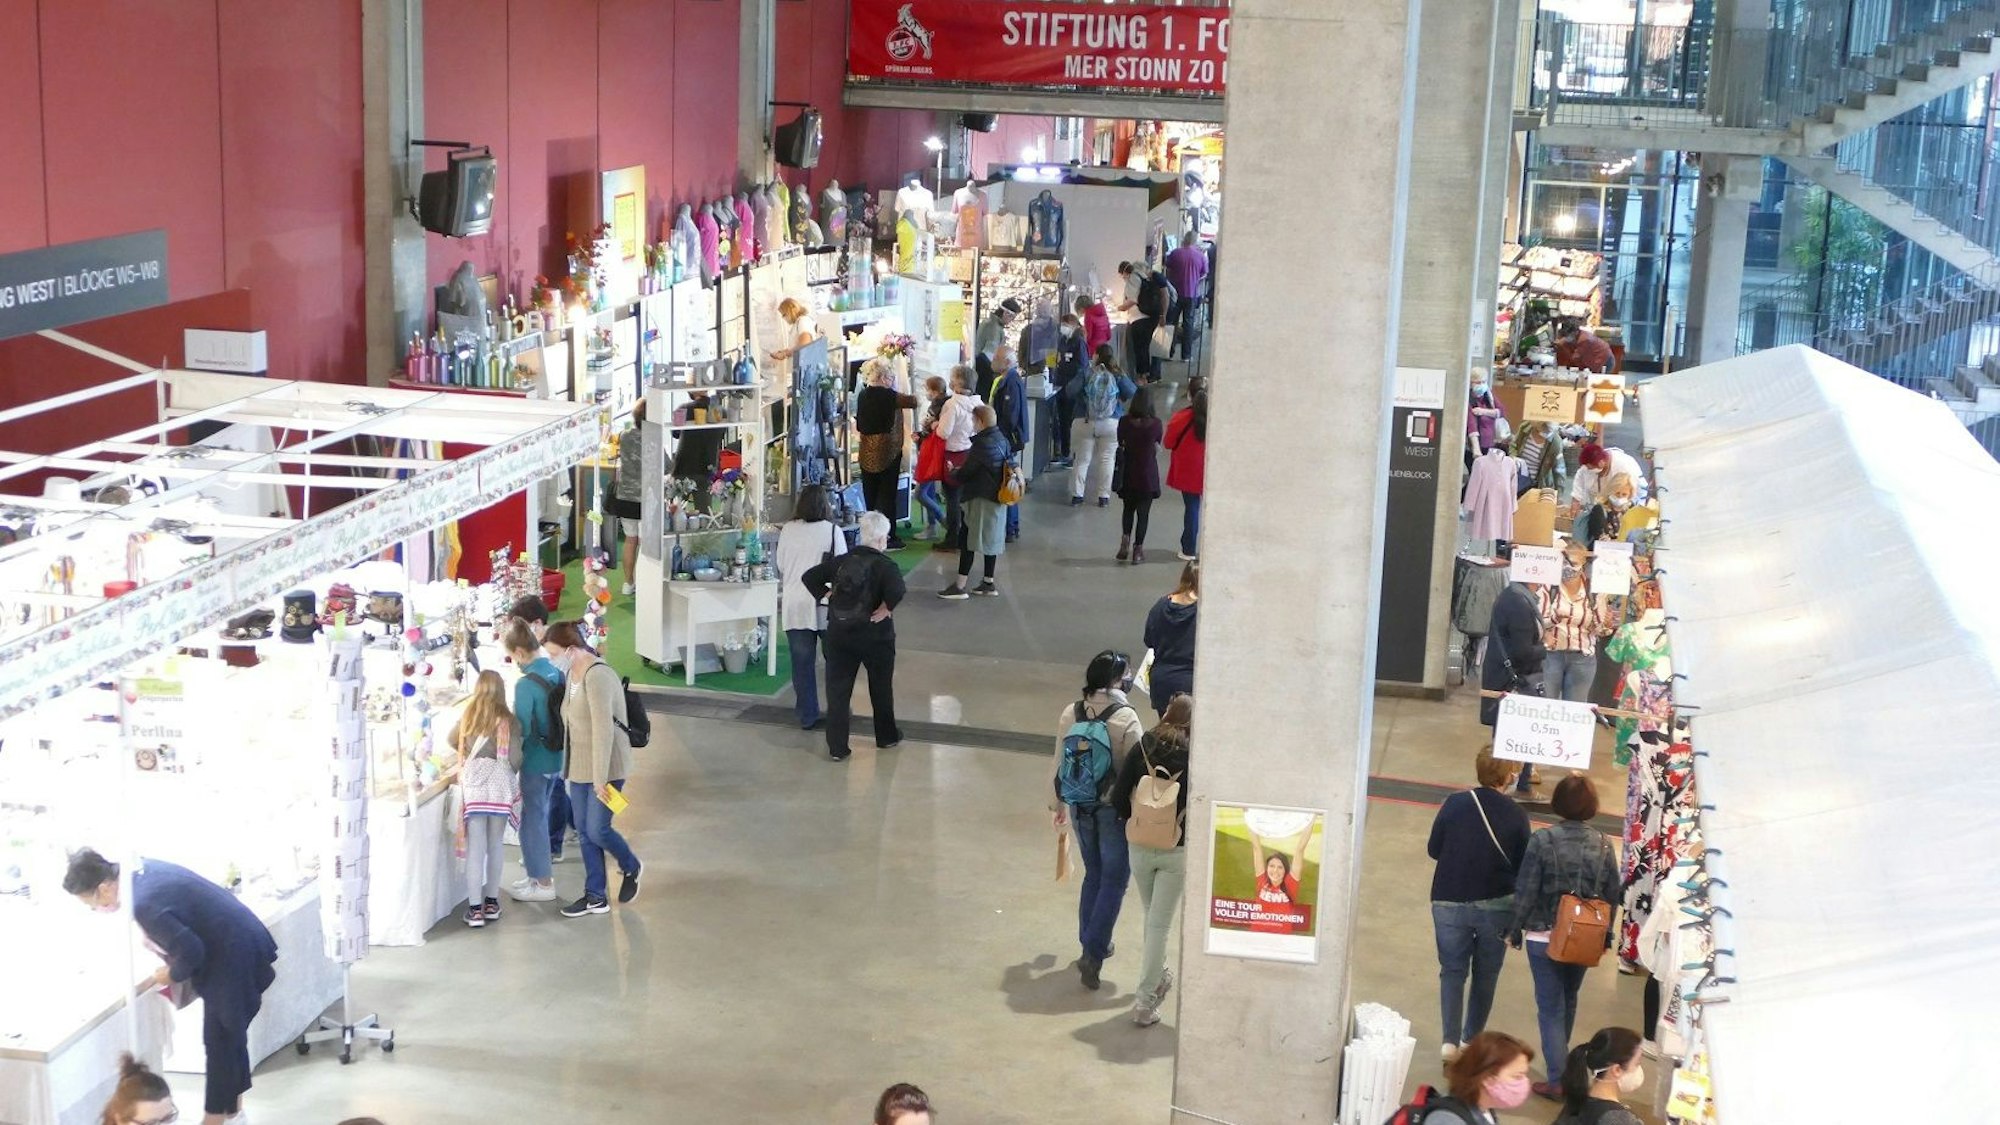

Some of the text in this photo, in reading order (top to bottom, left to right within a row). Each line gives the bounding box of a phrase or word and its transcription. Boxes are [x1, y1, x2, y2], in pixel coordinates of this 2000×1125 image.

[1002, 11, 1147, 50] STIFTUNG
[1162, 15, 1185, 51] 1.
[1065, 55, 1108, 79] MER
[1116, 57, 1182, 83] STONN
[1189, 59, 1215, 84] ZO
[16, 279, 56, 305] WEST
[63, 268, 114, 296] BLÖCKE
[1404, 446, 1436, 457] WEST
[1503, 699, 1592, 725] Bündchen
[1505, 738, 1545, 757] Stück
[1215, 899, 1262, 912] EINE TOUR
[1215, 908, 1249, 919] VOLLER
[1250, 912, 1304, 924] EMOTIONEN
